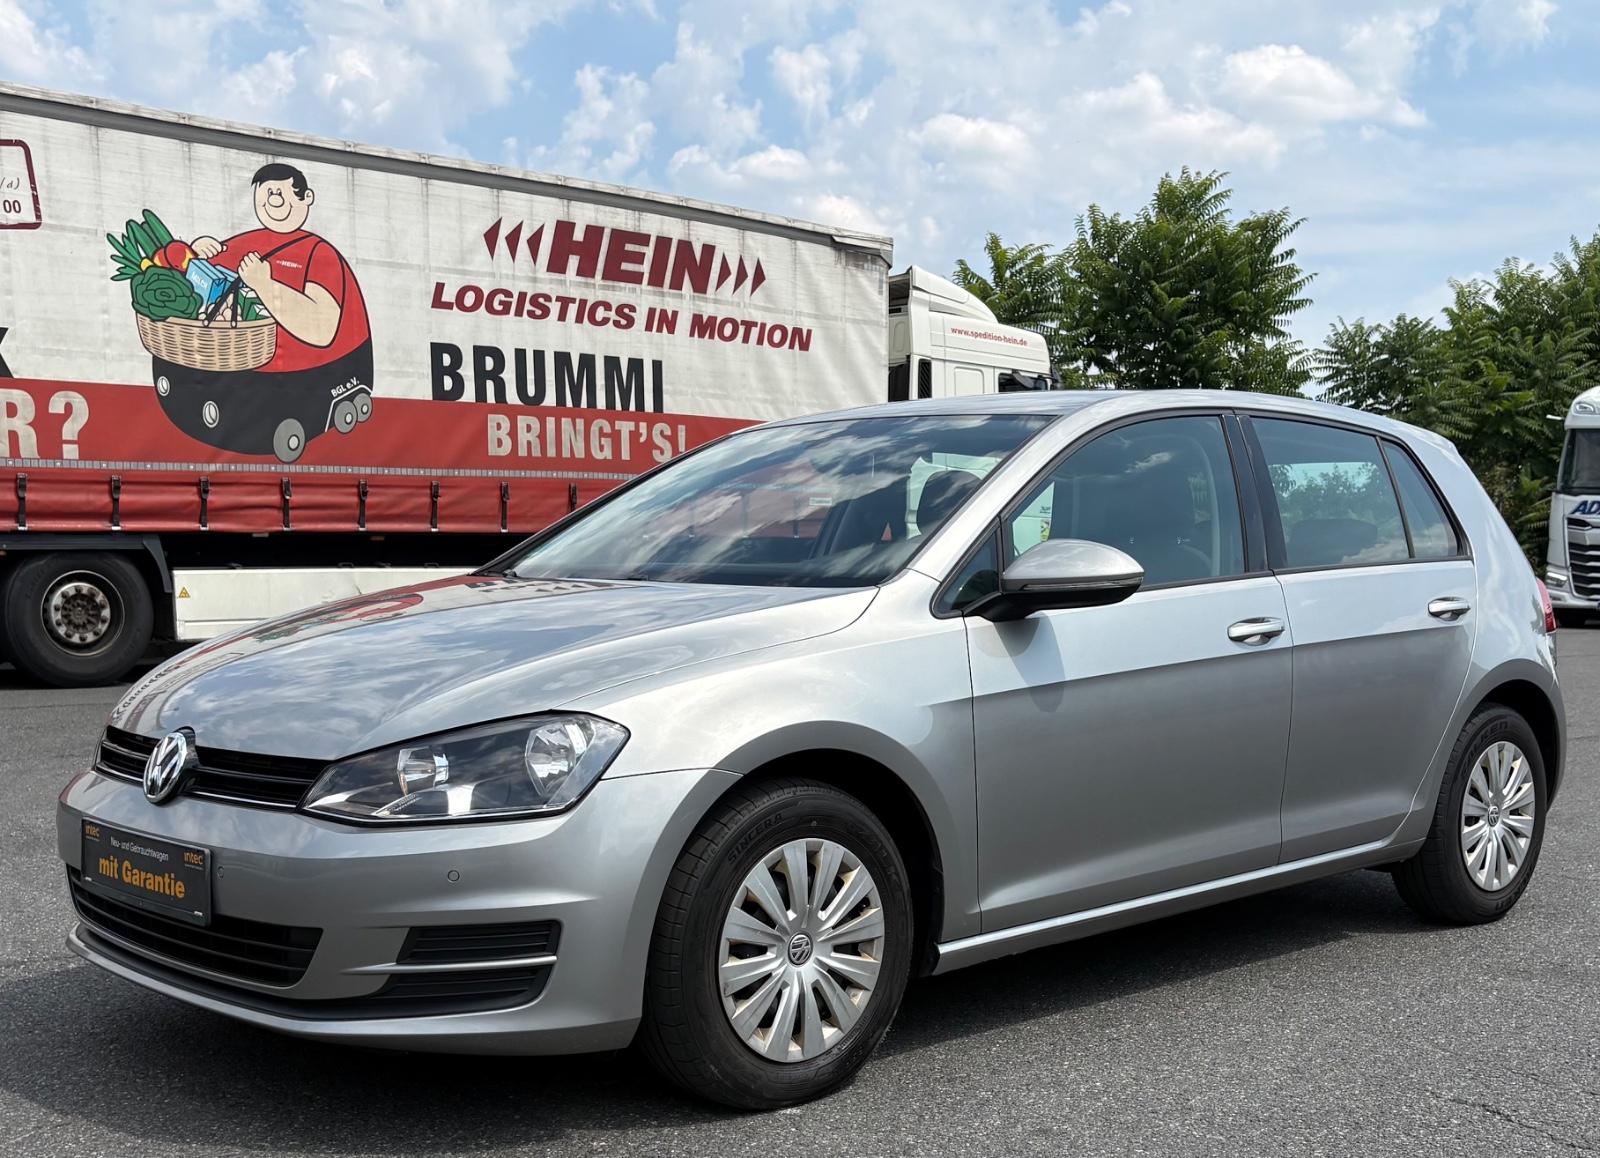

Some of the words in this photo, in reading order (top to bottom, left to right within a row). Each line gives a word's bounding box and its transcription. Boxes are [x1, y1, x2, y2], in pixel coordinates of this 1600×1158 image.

[546, 219, 716, 294] HEIN
[431, 282, 637, 330] LOGISTICS
[645, 307, 679, 335] IN
[689, 313, 813, 352] MOTION
[951, 328, 1027, 346] www.spedition-hein.de
[330, 384, 347, 398] BGL
[430, 341, 664, 413] BRUMMI
[487, 413, 687, 462] BRINGT'S!
[121, 842, 130, 850] und
[184, 851, 204, 866] intec
[727, 813, 784, 863] SINCERA
[98, 855, 119, 880] mit
[122, 860, 186, 898] Garantie
